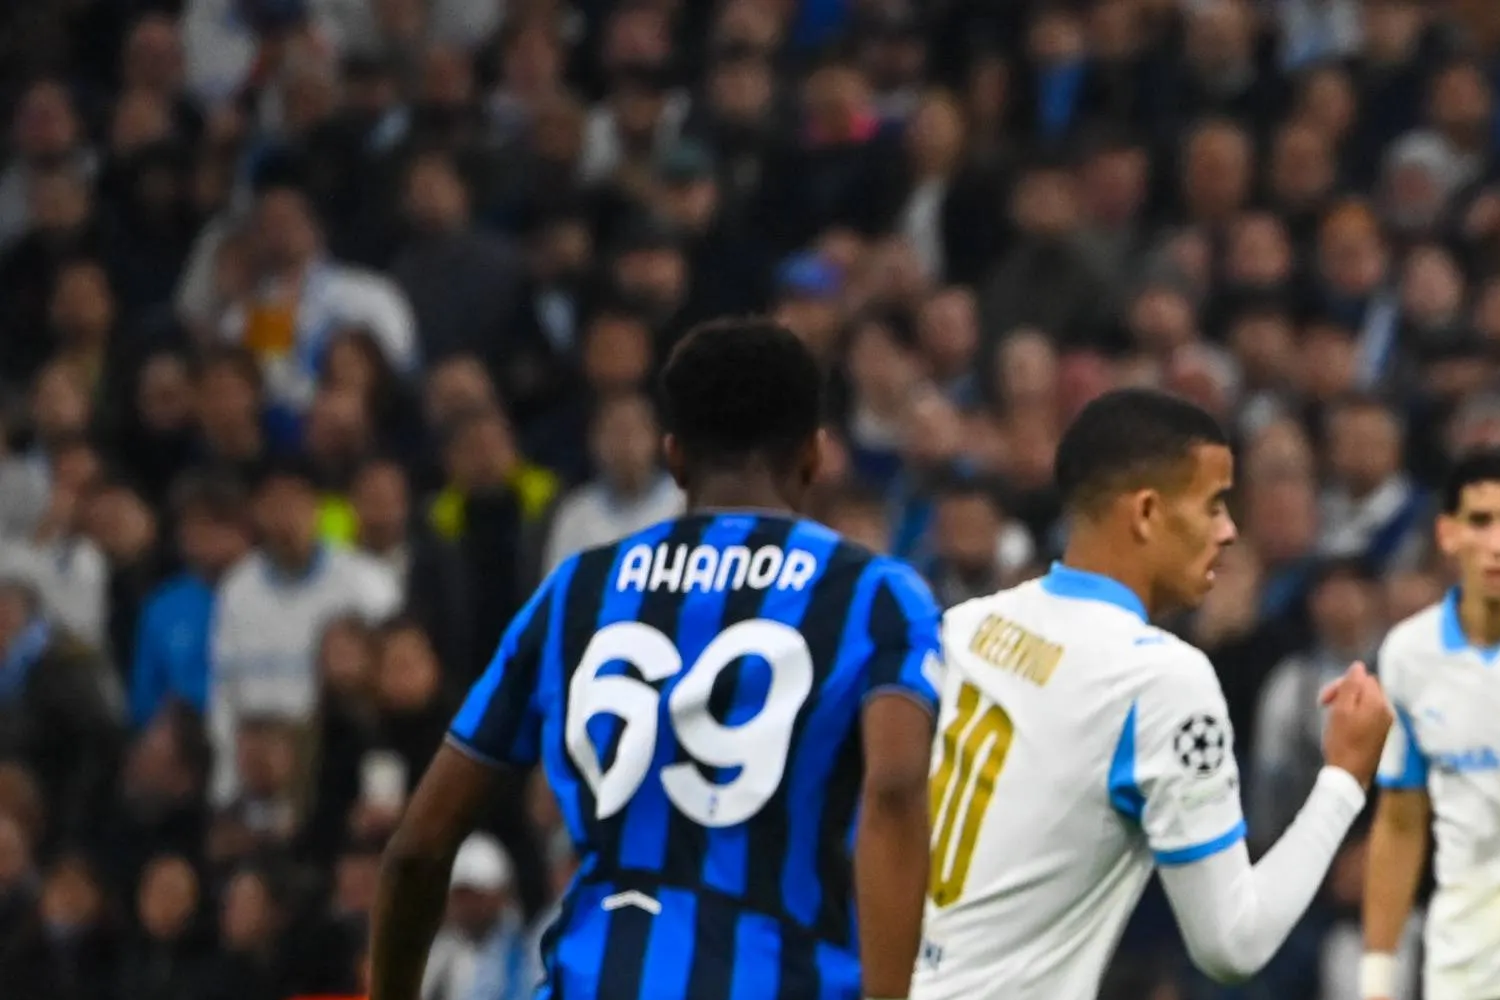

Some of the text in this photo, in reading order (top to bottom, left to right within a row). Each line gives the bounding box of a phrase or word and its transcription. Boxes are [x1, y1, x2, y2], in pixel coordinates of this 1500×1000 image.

[616, 543, 817, 592] AHANOR
[566, 618, 814, 828] 69
[929, 680, 1014, 909] 10
